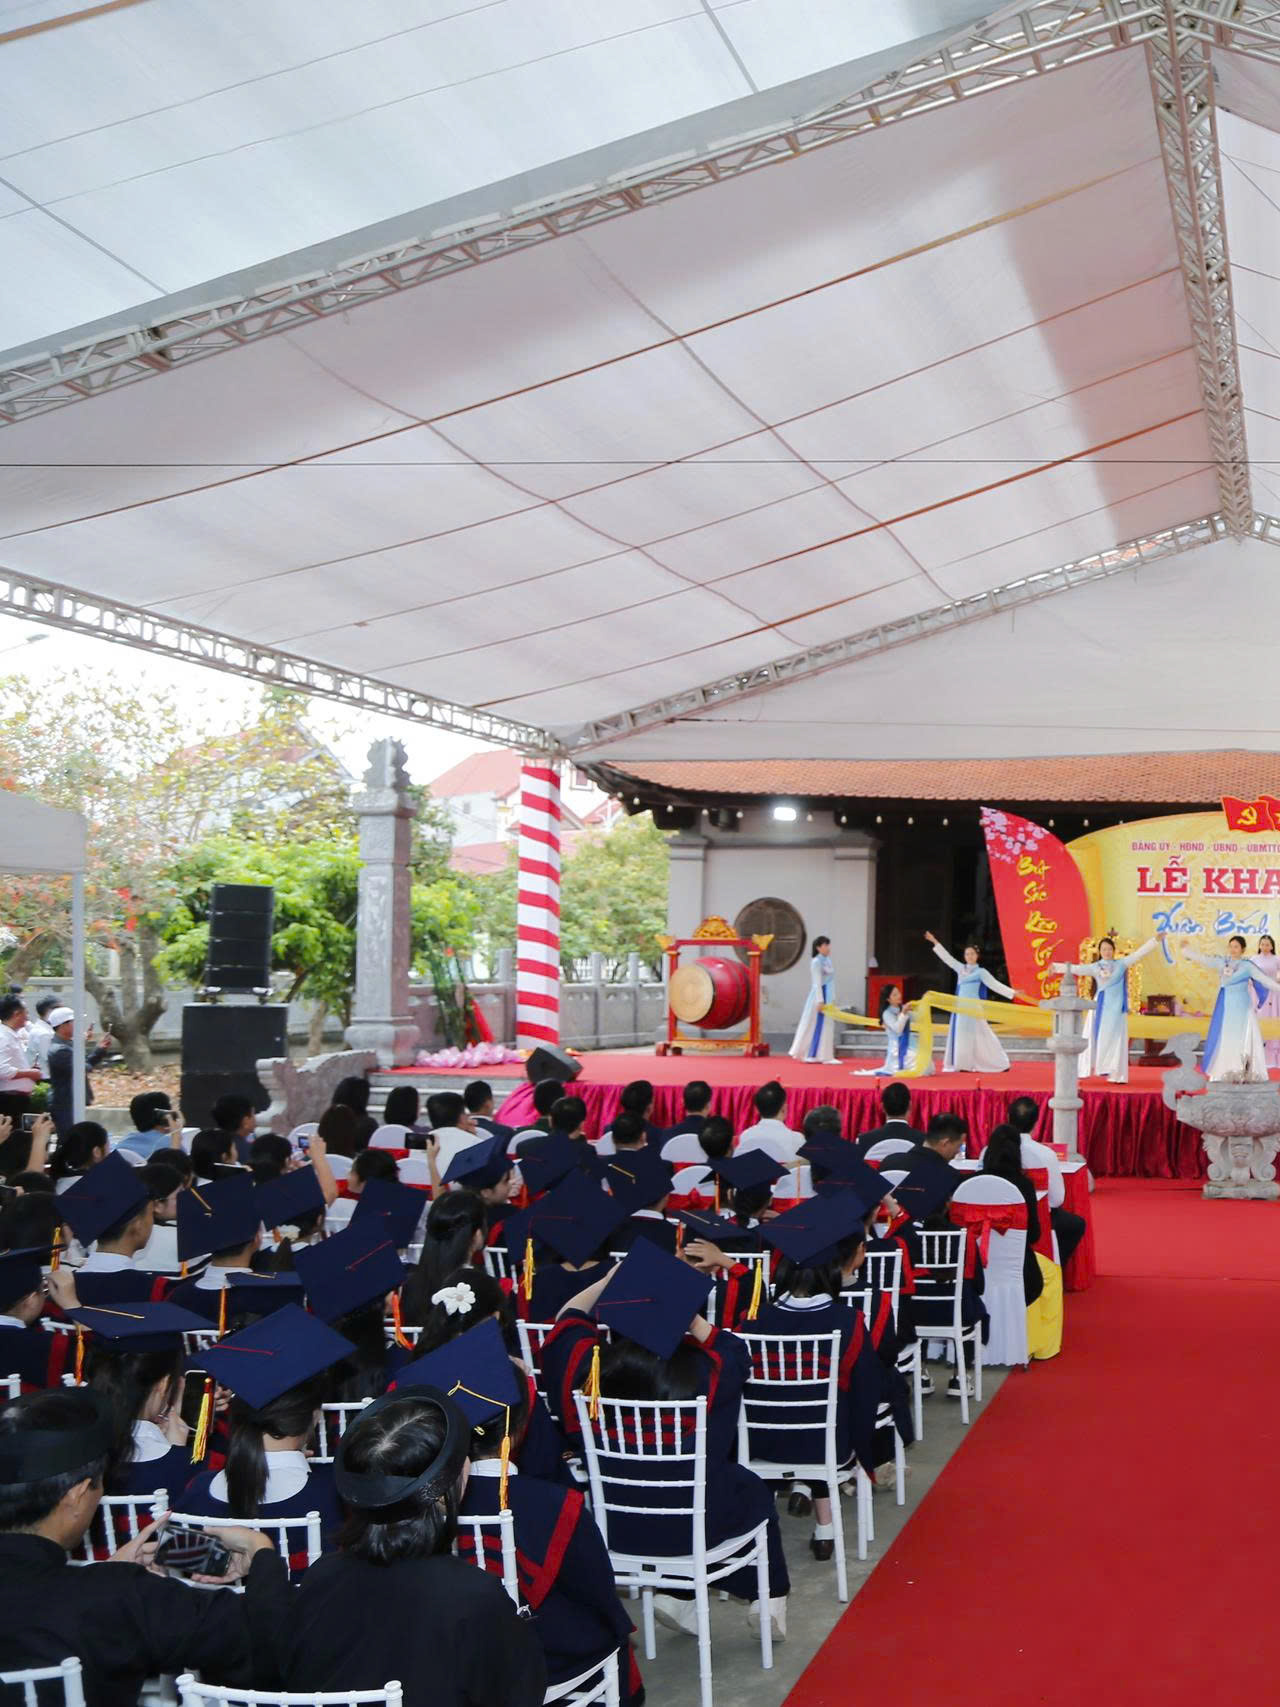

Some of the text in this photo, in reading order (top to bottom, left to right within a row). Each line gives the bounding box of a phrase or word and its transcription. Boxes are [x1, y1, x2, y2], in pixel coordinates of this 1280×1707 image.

[1213, 842, 1238, 853] UBND
[1137, 855, 1189, 896] LỄ
[1151, 900, 1204, 965] Xuân
